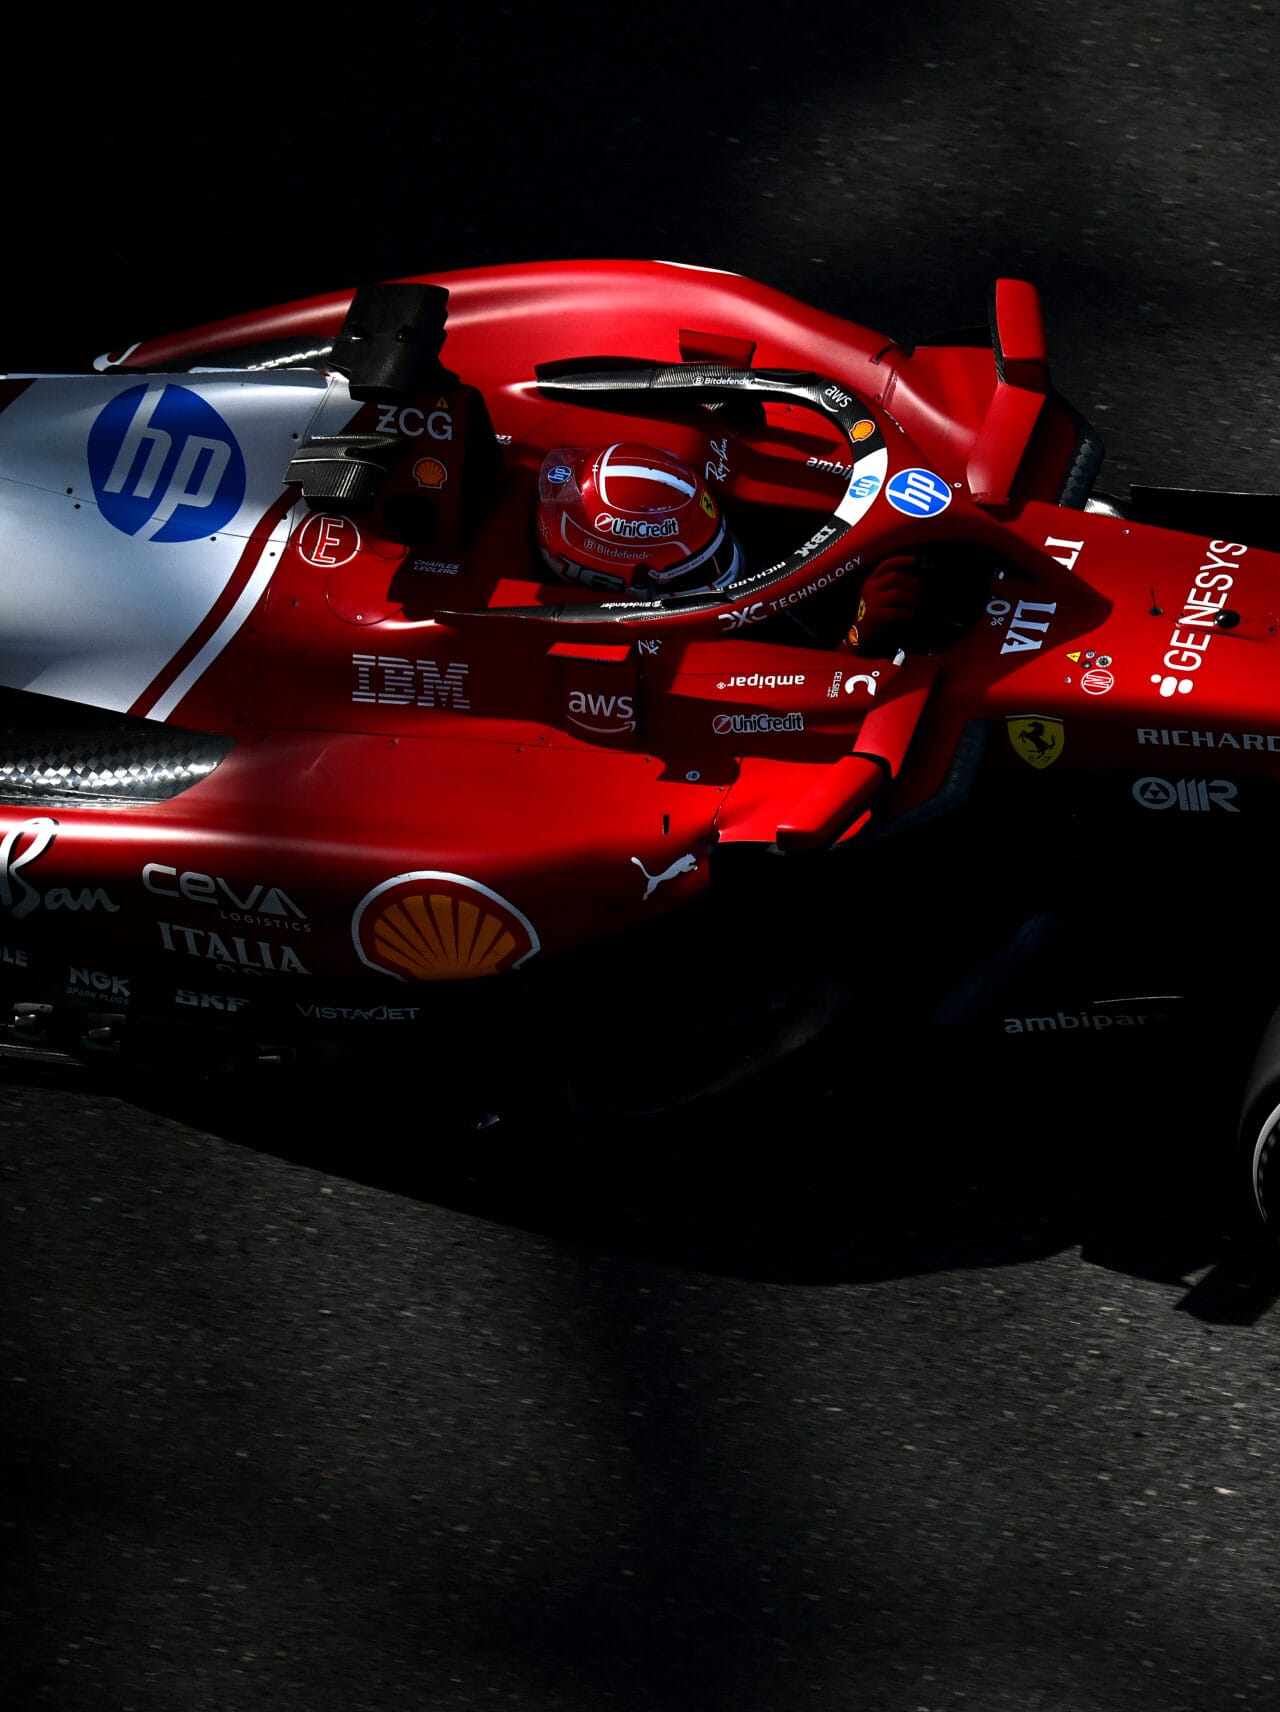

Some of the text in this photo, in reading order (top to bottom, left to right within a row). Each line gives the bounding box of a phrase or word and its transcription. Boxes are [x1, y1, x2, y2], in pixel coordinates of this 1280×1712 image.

[824, 384, 853, 408] aws
[102, 384, 231, 541] hp
[549, 466, 571, 484] hp
[848, 475, 882, 499] hp
[889, 470, 947, 517] hp
[312, 514, 345, 564] E
[612, 517, 680, 539] UniCredit
[793, 525, 837, 558] IBM
[728, 561, 787, 590] RICHARD
[769, 555, 865, 611] TECHNOLOGY
[1164, 539, 1249, 671] GENESYS
[351, 653, 471, 710] IBM
[728, 672, 806, 690] ambipar
[567, 689, 634, 720] aws
[732, 712, 805, 734] UniCredit
[218, 909, 313, 934] LOGISTICS
[156, 920, 313, 976] ITALIA
[67, 964, 131, 998] NGK
[1003, 1010, 1150, 1035] ambipar
